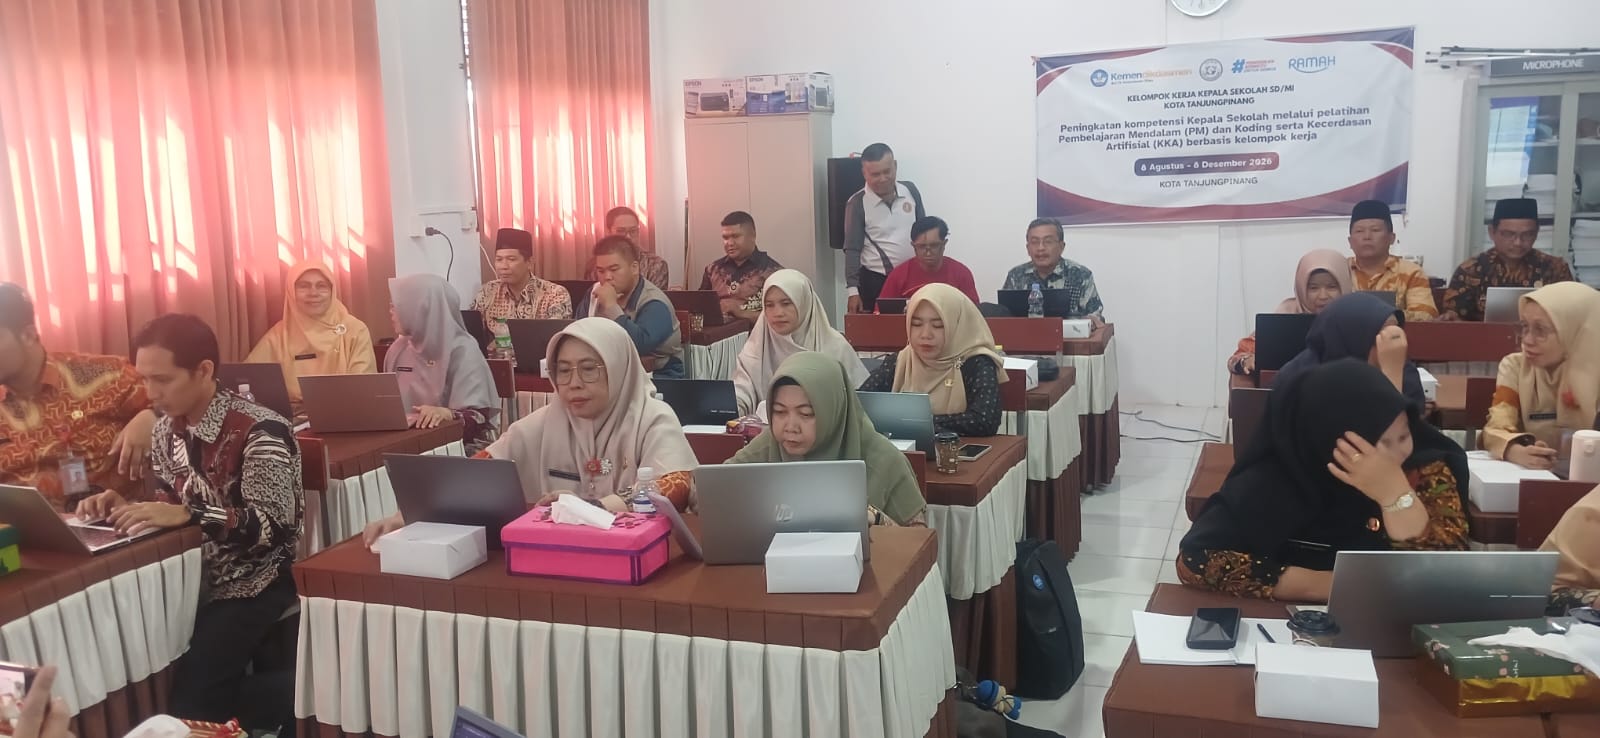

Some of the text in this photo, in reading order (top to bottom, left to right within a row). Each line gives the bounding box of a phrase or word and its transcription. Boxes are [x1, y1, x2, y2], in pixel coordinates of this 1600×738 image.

[1288, 56, 1336, 70] RAMAH
[1522, 59, 1585, 70] MICROPHONE
[1127, 84, 1295, 102] KELOMPOK KERJA KEPALA SEKOLAH SD/MI
[1164, 97, 1255, 109] KOTA TANJUNGPINANG
[1060, 105, 1370, 133] Peningkatan kompetensi Kepala Sekolah melalui pelatihan
[1058, 118, 1372, 143] Pembelajaran Mendalam (PM) dan Koding serta Kecerdasan
[1106, 131, 1318, 151] Artifisial (KKA) berbasis kelompok kerja
[1149, 162, 1185, 172] Agustus
[1201, 159, 1247, 169] Desember
[1159, 177, 1258, 188] KOTA TANJUNGPINANG
